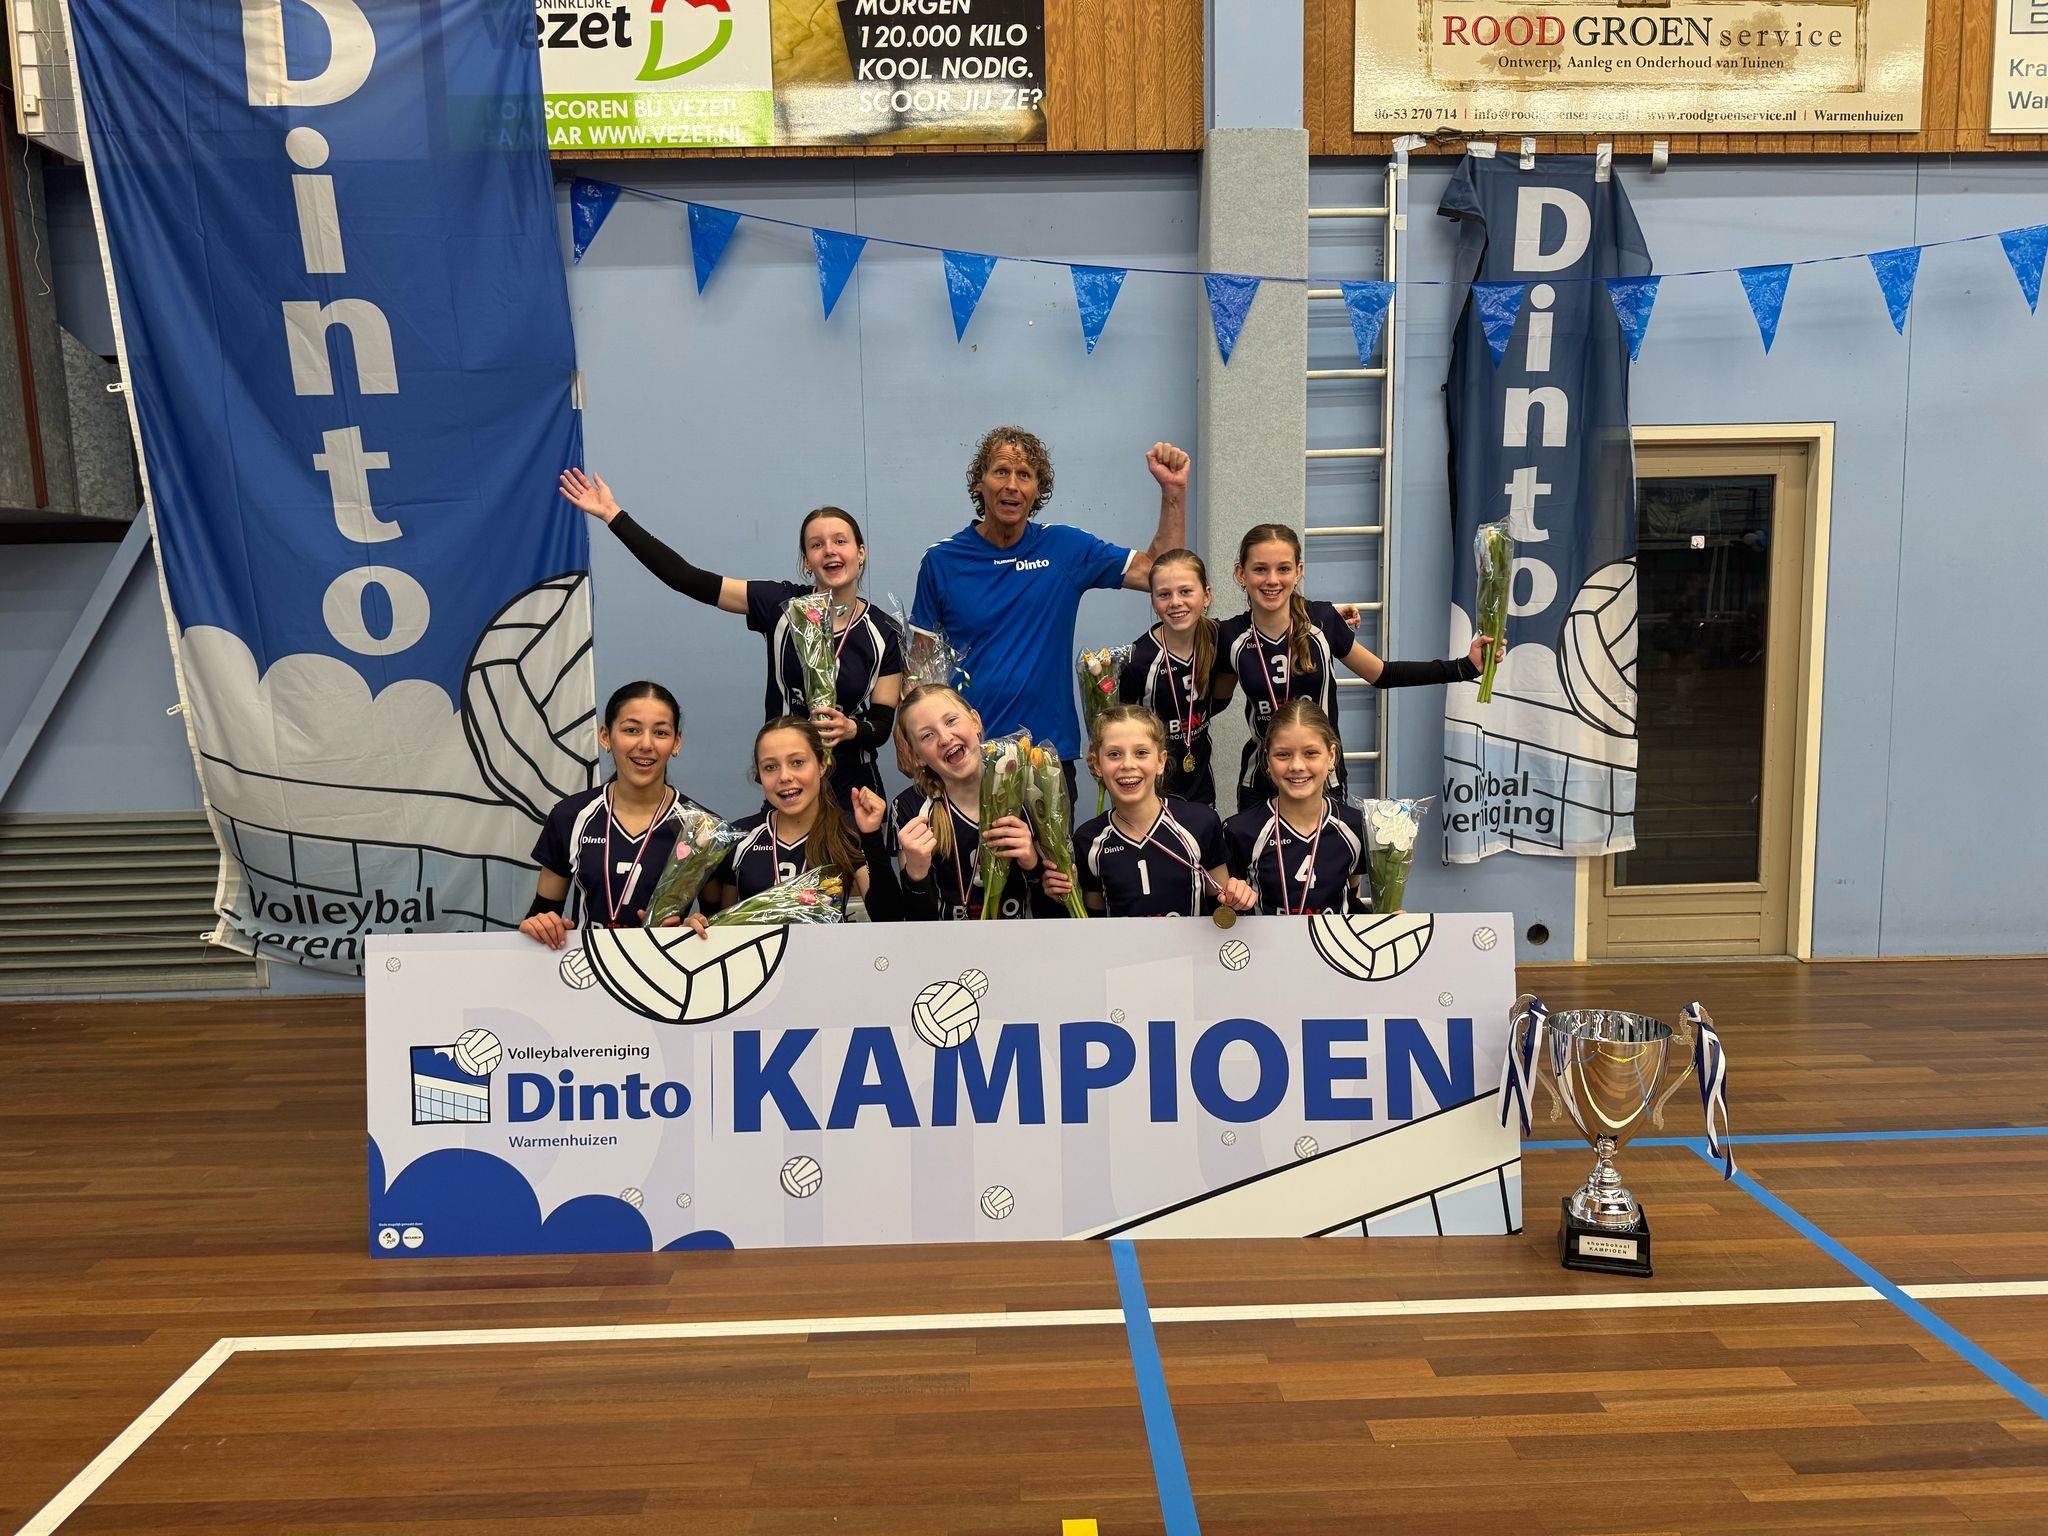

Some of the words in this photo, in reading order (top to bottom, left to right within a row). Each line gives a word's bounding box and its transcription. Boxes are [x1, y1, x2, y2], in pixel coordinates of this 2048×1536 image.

[855, 0, 971, 16] MORGEN
[860, 24, 961, 48] 120.000
[969, 23, 1028, 47] KILO
[1442, 16, 1565, 46] ROOD
[1572, 16, 1713, 46] GROEN
[1719, 22, 1842, 47] service
[858, 58, 933, 81] KOOL
[941, 56, 1034, 80] NODIG.
[1498, 55, 1562, 72] Ontwerp,
[1567, 55, 1612, 72] Aanleg
[1617, 59, 1632, 69] en
[1636, 55, 1712, 69] Onderhoud
[1716, 59, 1738, 69] van
[1741, 56, 1784, 69] Tuinen
[544, 99, 628, 120] SCOREN
[635, 99, 661, 119] BIJ
[667, 98, 737, 118] VEZET!
[859, 90, 950, 113] SCOOR
[961, 89, 991, 111] JIJ
[1000, 88, 1043, 111] ZE?
[1411, 108, 1432, 120] 270
[1436, 108, 1457, 120] 714
[1814, 109, 1904, 122] Warmenhuizen
[589, 125, 743, 145] WWW.VEZET.NL
[241, 0, 431, 656] Dinto
[1502, 186, 1592, 617] Dinto
[1015, 559, 1050, 571] Dinto
[1271, 654, 1288, 684] 3
[581, 836, 606, 844] Dinto
[1104, 845, 1125, 854] Dinto
[616, 862, 642, 905] 7
[1137, 859, 1151, 895] 1
[1294, 854, 1317, 889] 4
[247, 887, 436, 935] Volleybal
[507, 1044, 650, 1063] Volleybalvereniging
[733, 1016, 1475, 1133] KAMPIOEN
[507, 1068, 692, 1123] Dinto
[508, 1133, 618, 1148] Warmenhuizen
